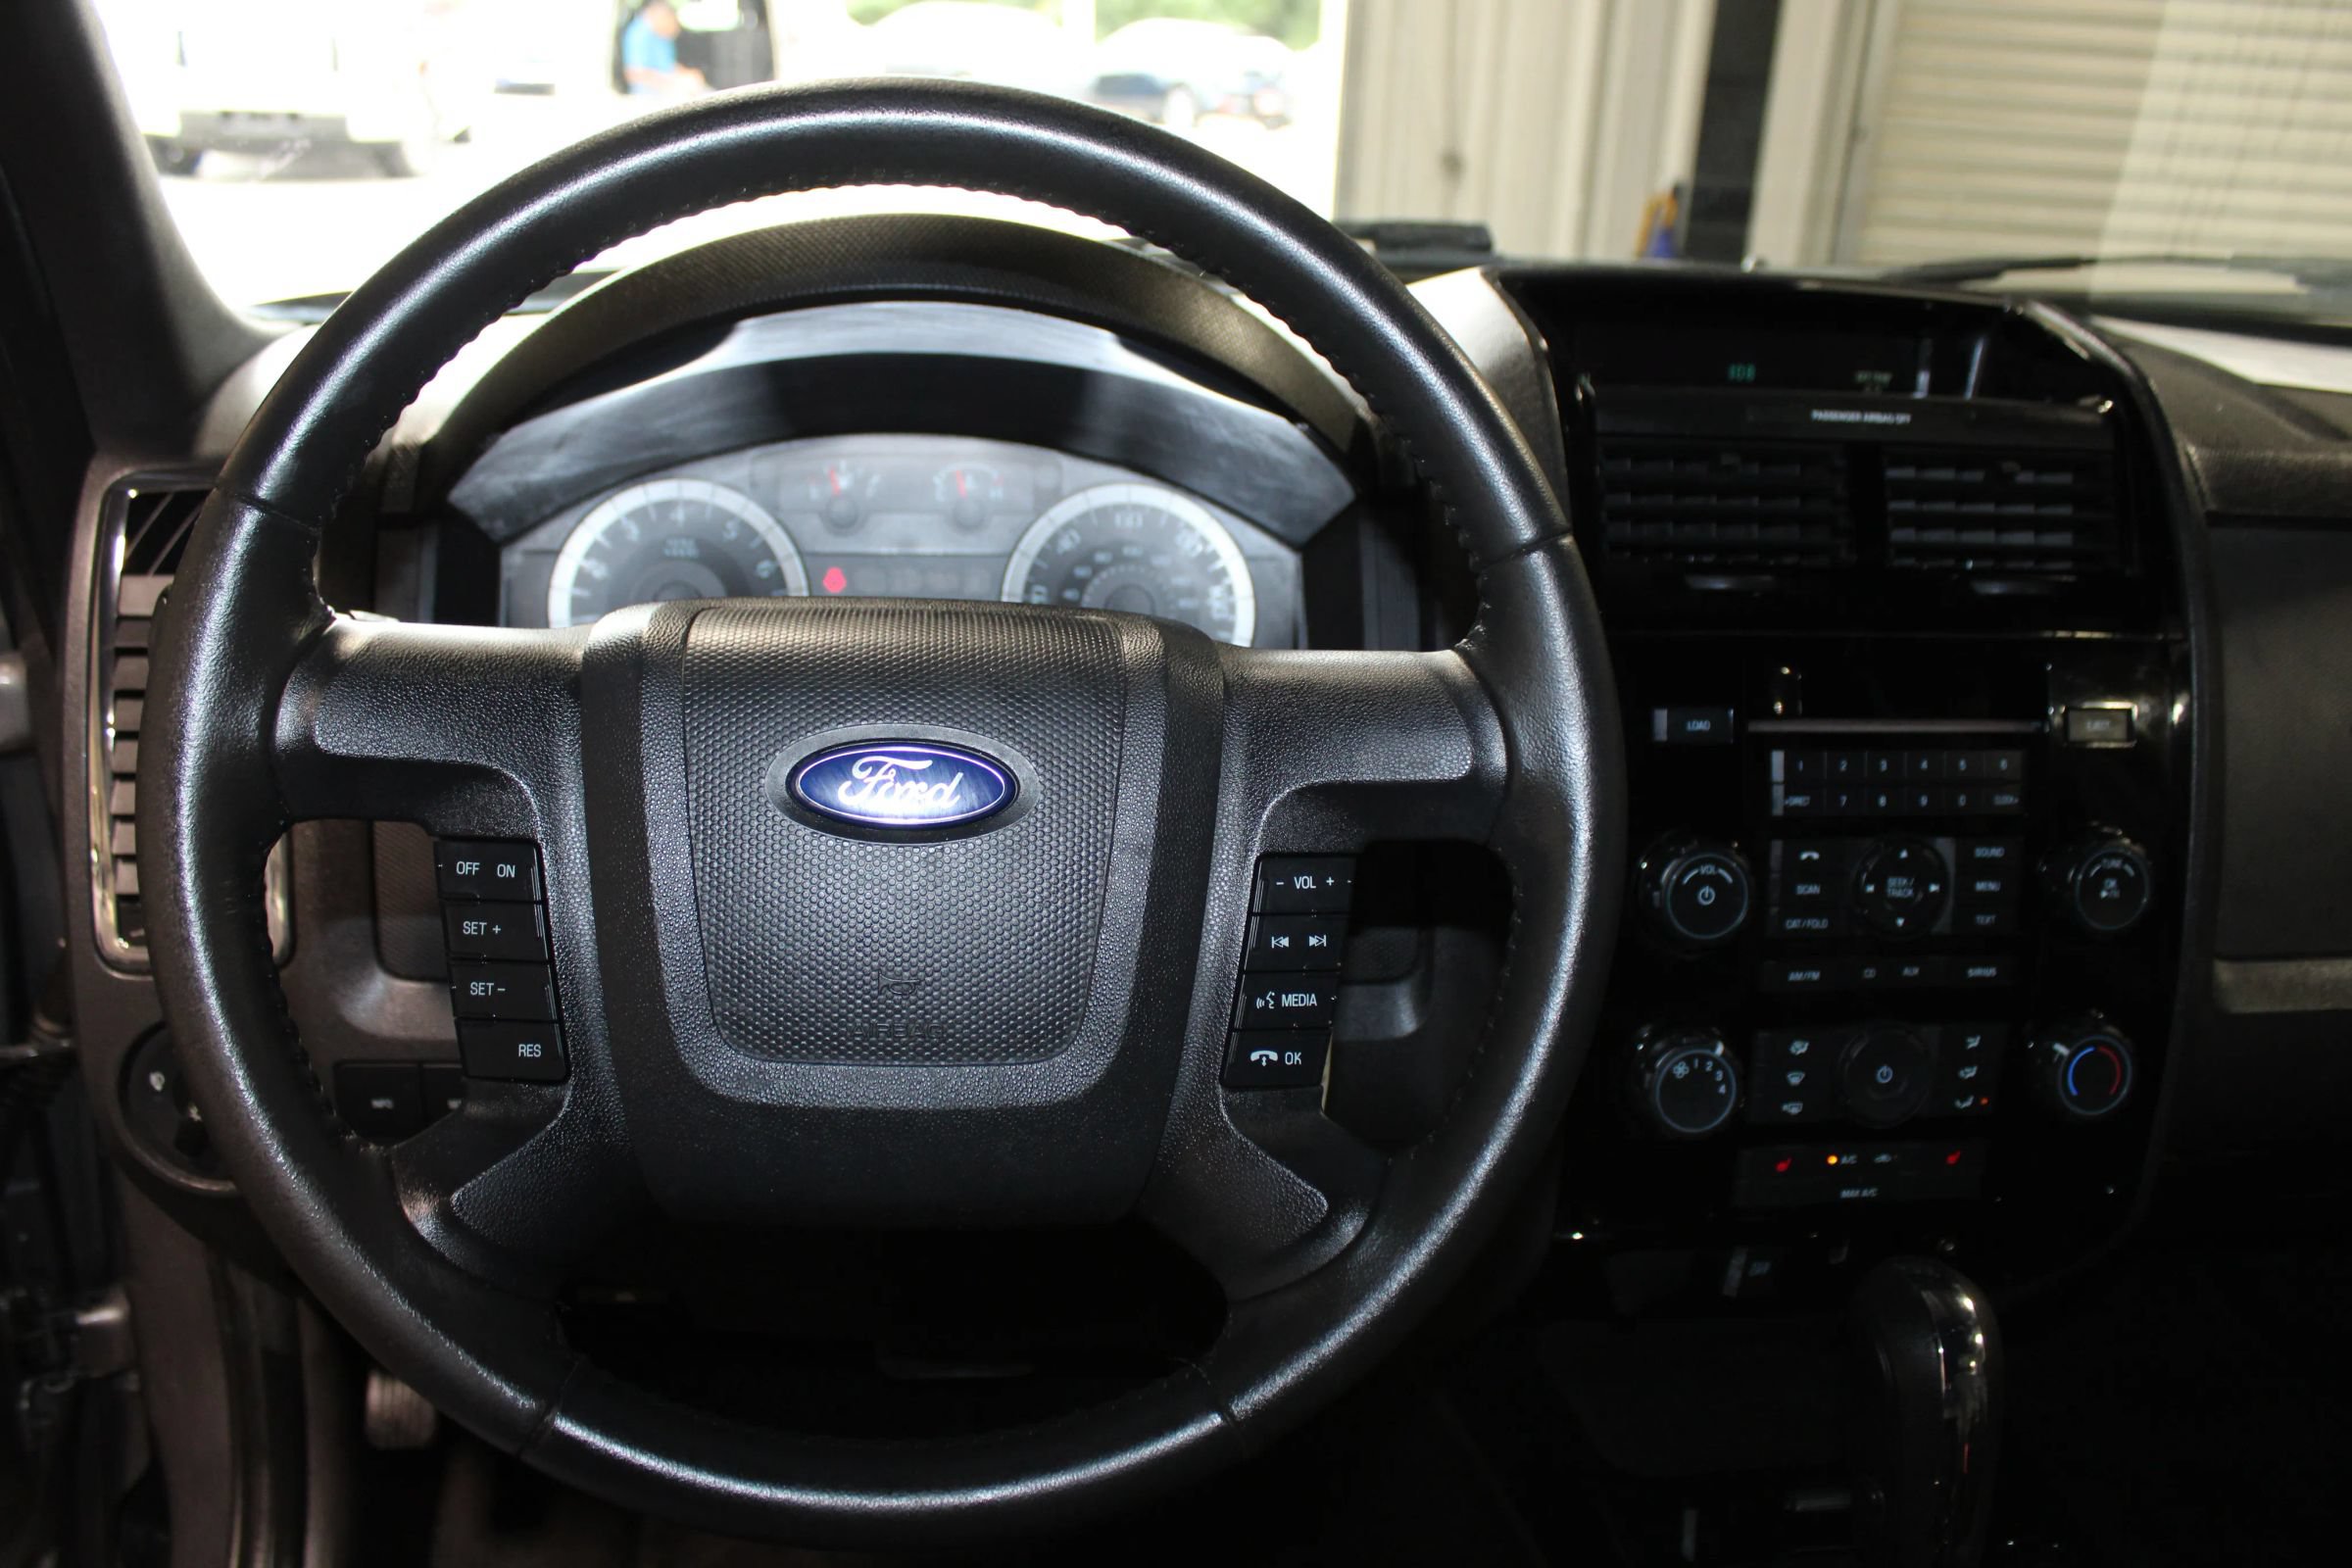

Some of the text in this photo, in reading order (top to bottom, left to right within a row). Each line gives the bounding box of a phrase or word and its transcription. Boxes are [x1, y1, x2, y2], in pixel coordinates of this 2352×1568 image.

[1687, 720, 1711, 732] LOAD
[837, 756, 964, 811] Ford
[1839, 795, 1847, 808] 7
[456, 860, 516, 878] OFF ON
[1700, 864, 1716, 875] VOL
[1294, 876, 1317, 889] VOL
[1796, 884, 1821, 895] SCAN
[463, 921, 488, 935] SET
[470, 982, 495, 996] SET
[1281, 993, 1318, 1007] MEDIA
[852, 1022, 944, 1038] AIRBAG
[518, 1044, 542, 1057] RES
[1285, 1052, 1302, 1065] OK
